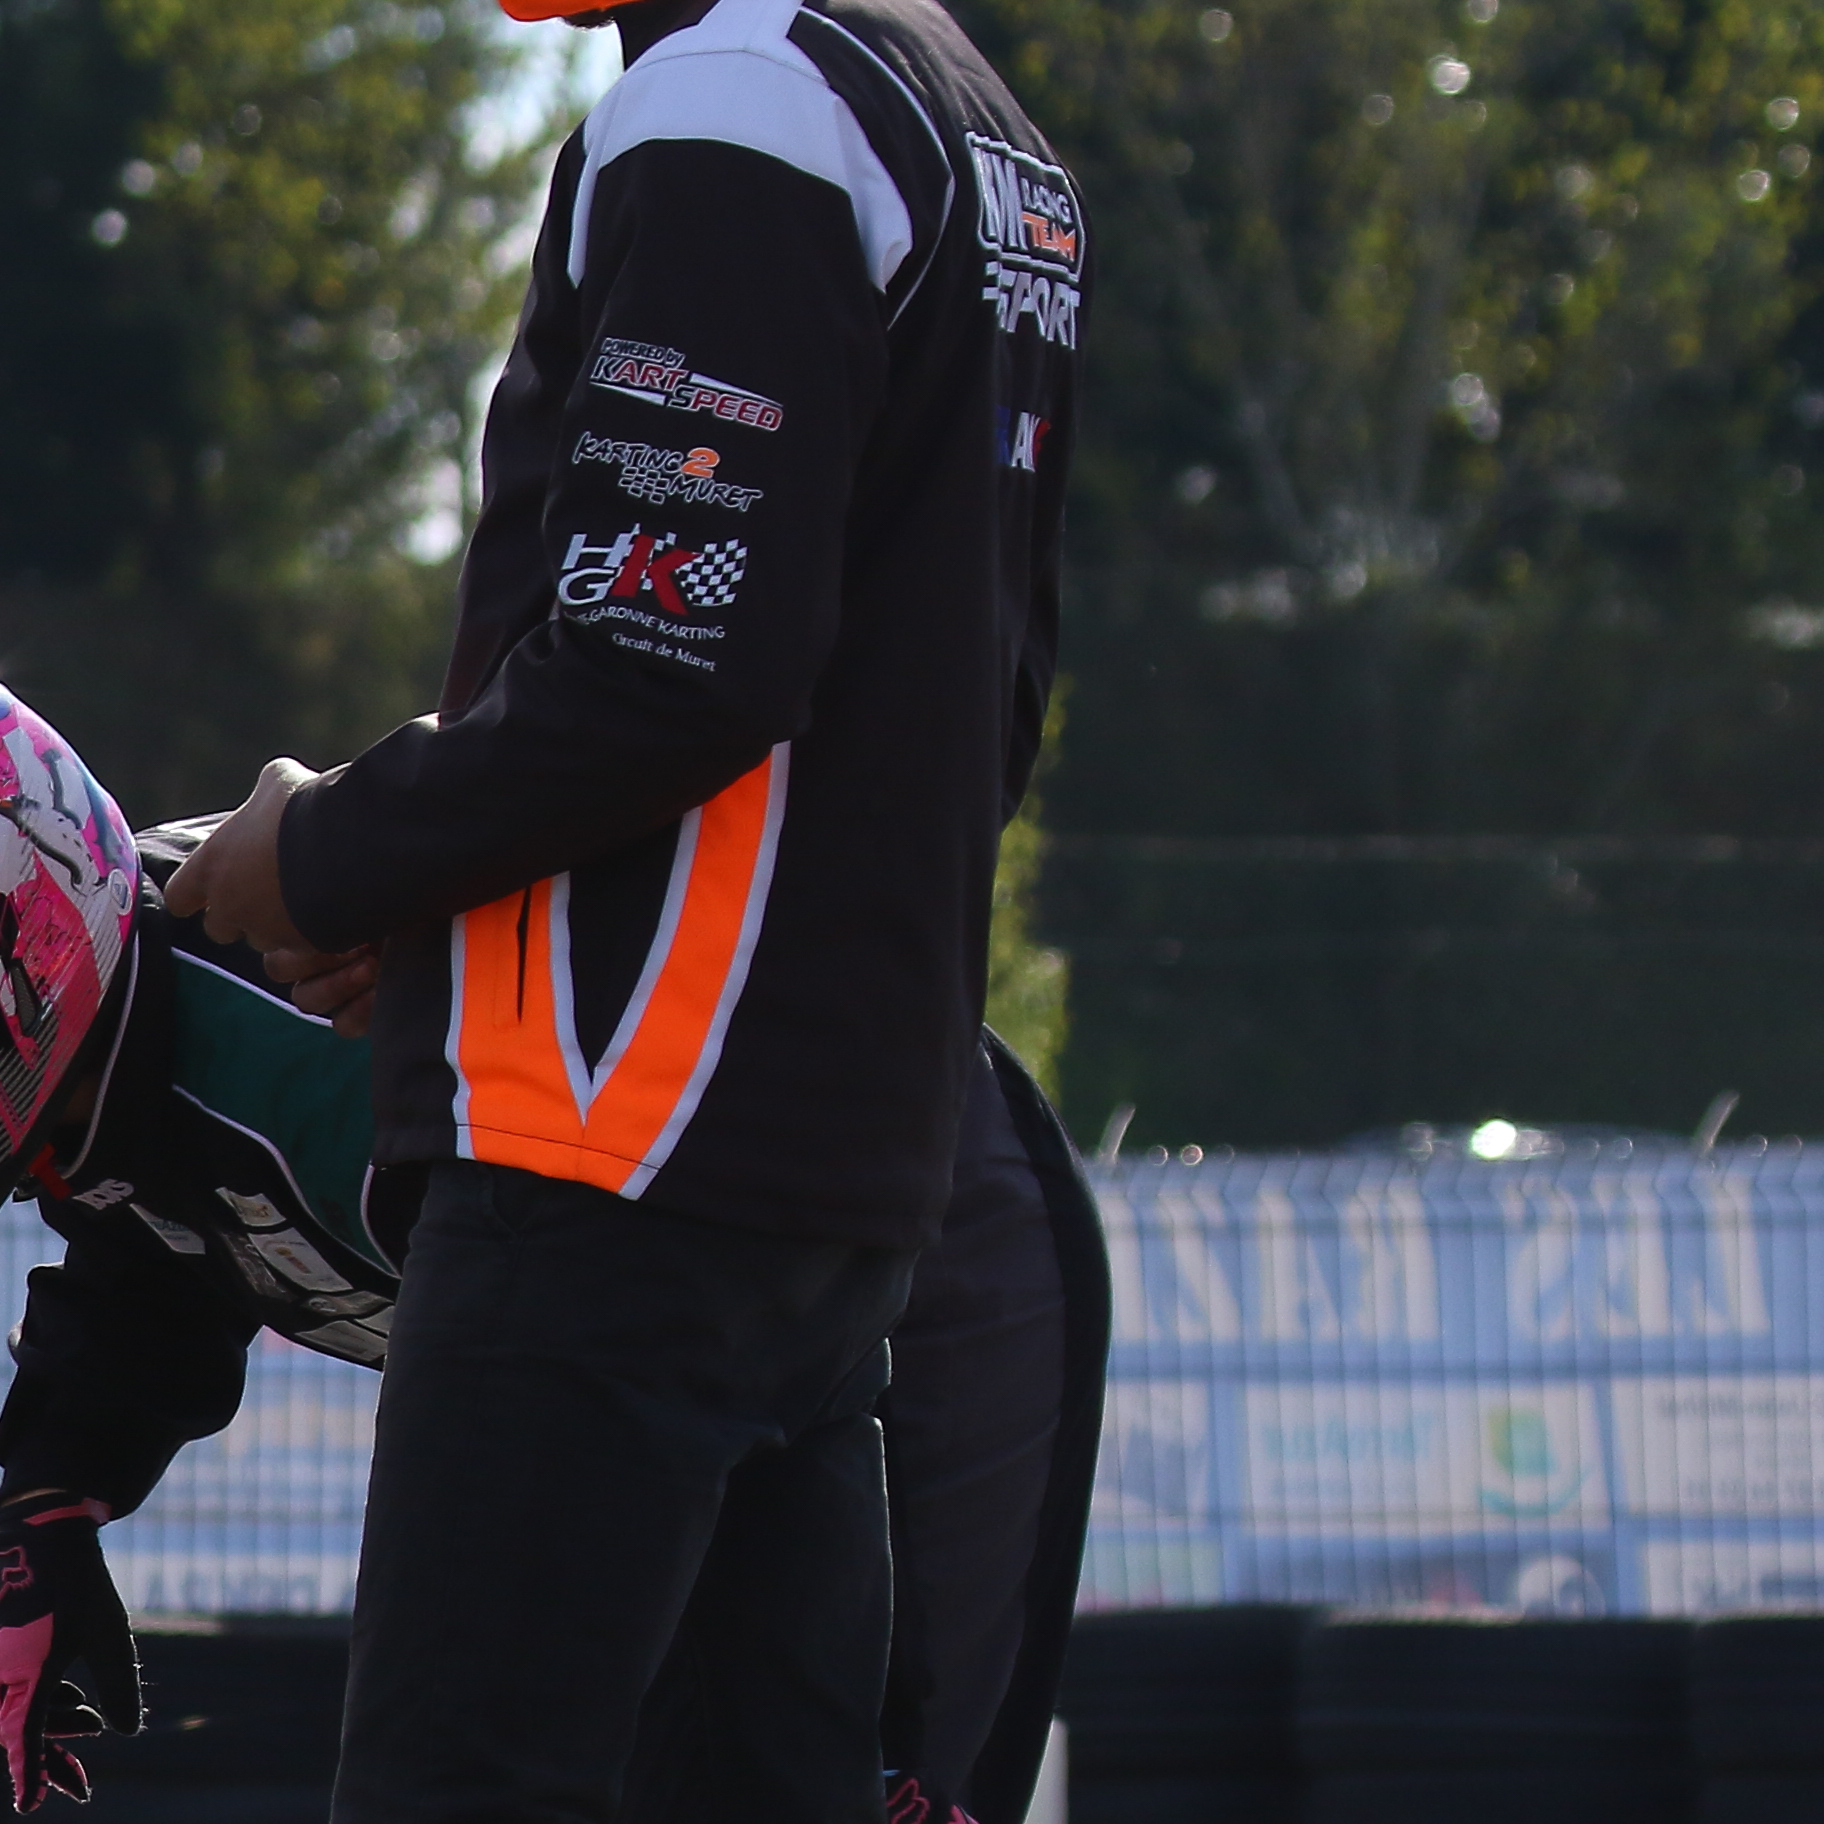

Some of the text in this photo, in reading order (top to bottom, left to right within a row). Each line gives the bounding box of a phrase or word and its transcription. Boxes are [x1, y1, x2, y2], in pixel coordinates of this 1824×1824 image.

[1023, 212, 1076, 262] TEAM
[603, 337, 686, 369] POWERED by
[590, 356, 689, 391] KART
[668, 385, 784, 431] SPEED
[572, 431, 721, 478] KARTING 2
[668, 474, 764, 512] MURET
[654, 619, 725, 641] KARTING
[612, 632, 716, 672] Circuit de Muret
